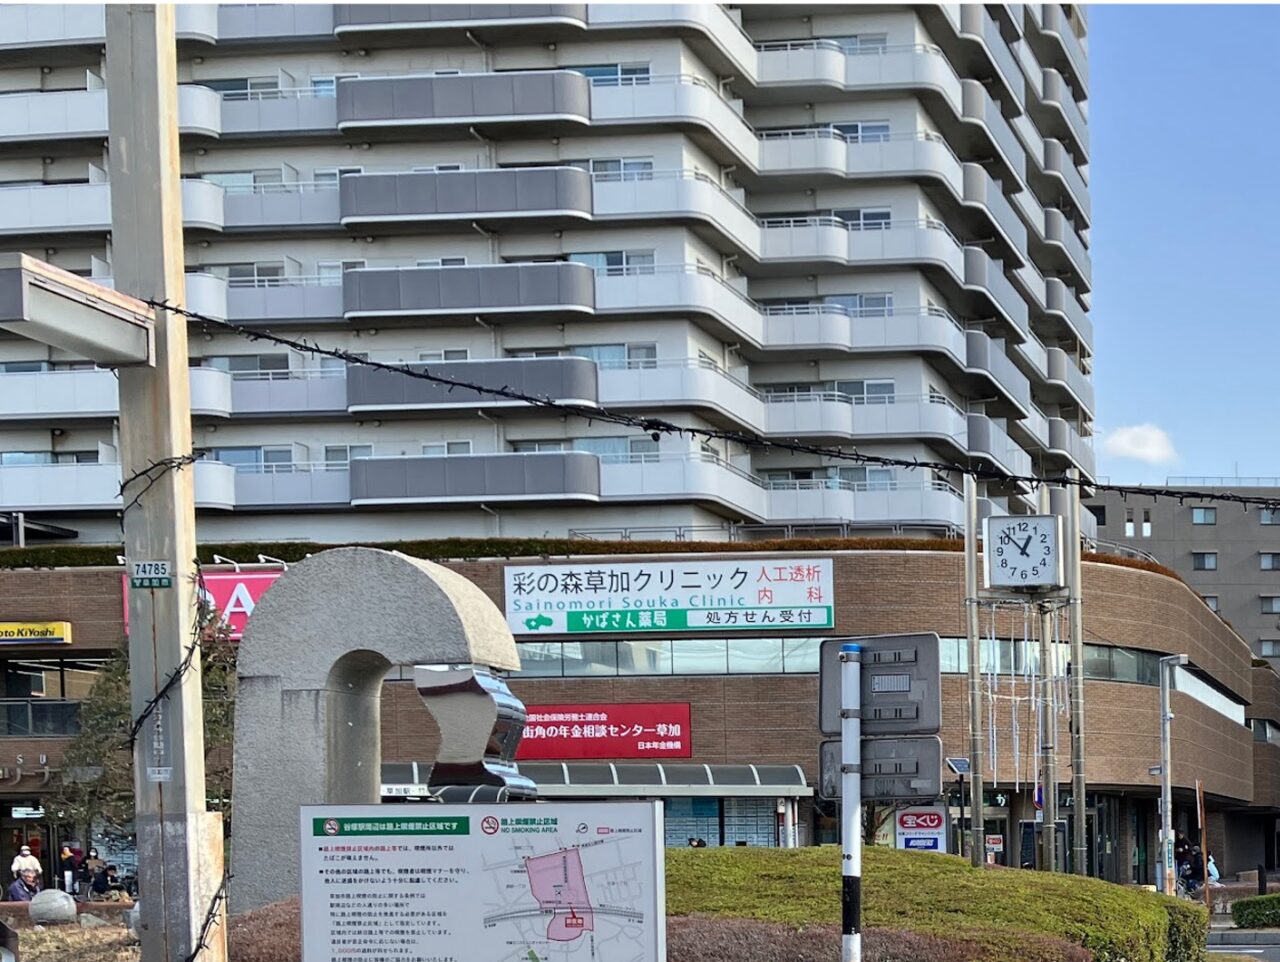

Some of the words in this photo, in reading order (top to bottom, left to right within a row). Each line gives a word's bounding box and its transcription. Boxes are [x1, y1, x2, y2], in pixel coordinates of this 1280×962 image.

[1006, 526, 1016, 536] 11
[1017, 522, 1028, 532] 12
[1033, 526, 1037, 535] 1
[999, 535, 1010, 545] 10
[1040, 534, 1047, 543] 2
[996, 547, 1004, 556] 9
[1044, 546, 1051, 555] 3
[1001, 558, 1008, 568] 8
[1040, 558, 1046, 567] 4
[135, 563, 167, 575] 74785
[1010, 567, 1017, 576] 7
[1032, 566, 1039, 576] 5
[1021, 570, 1028, 579] 6
[513, 567, 749, 595] 彩の森草加クリニック
[756, 565, 821, 583] 人工透析
[513, 597, 612, 612] Sainomori
[622, 595, 679, 610] Souka
[689, 594, 746, 608] Clinic
[582, 610, 667, 629] かばさん薬局
[706, 610, 813, 625] 処方せん受付
[522, 724, 681, 739] 街角の年金相談センター草加
[637, 741, 682, 750] 日本年金機構
[903, 814, 938, 827] 宝くじ
